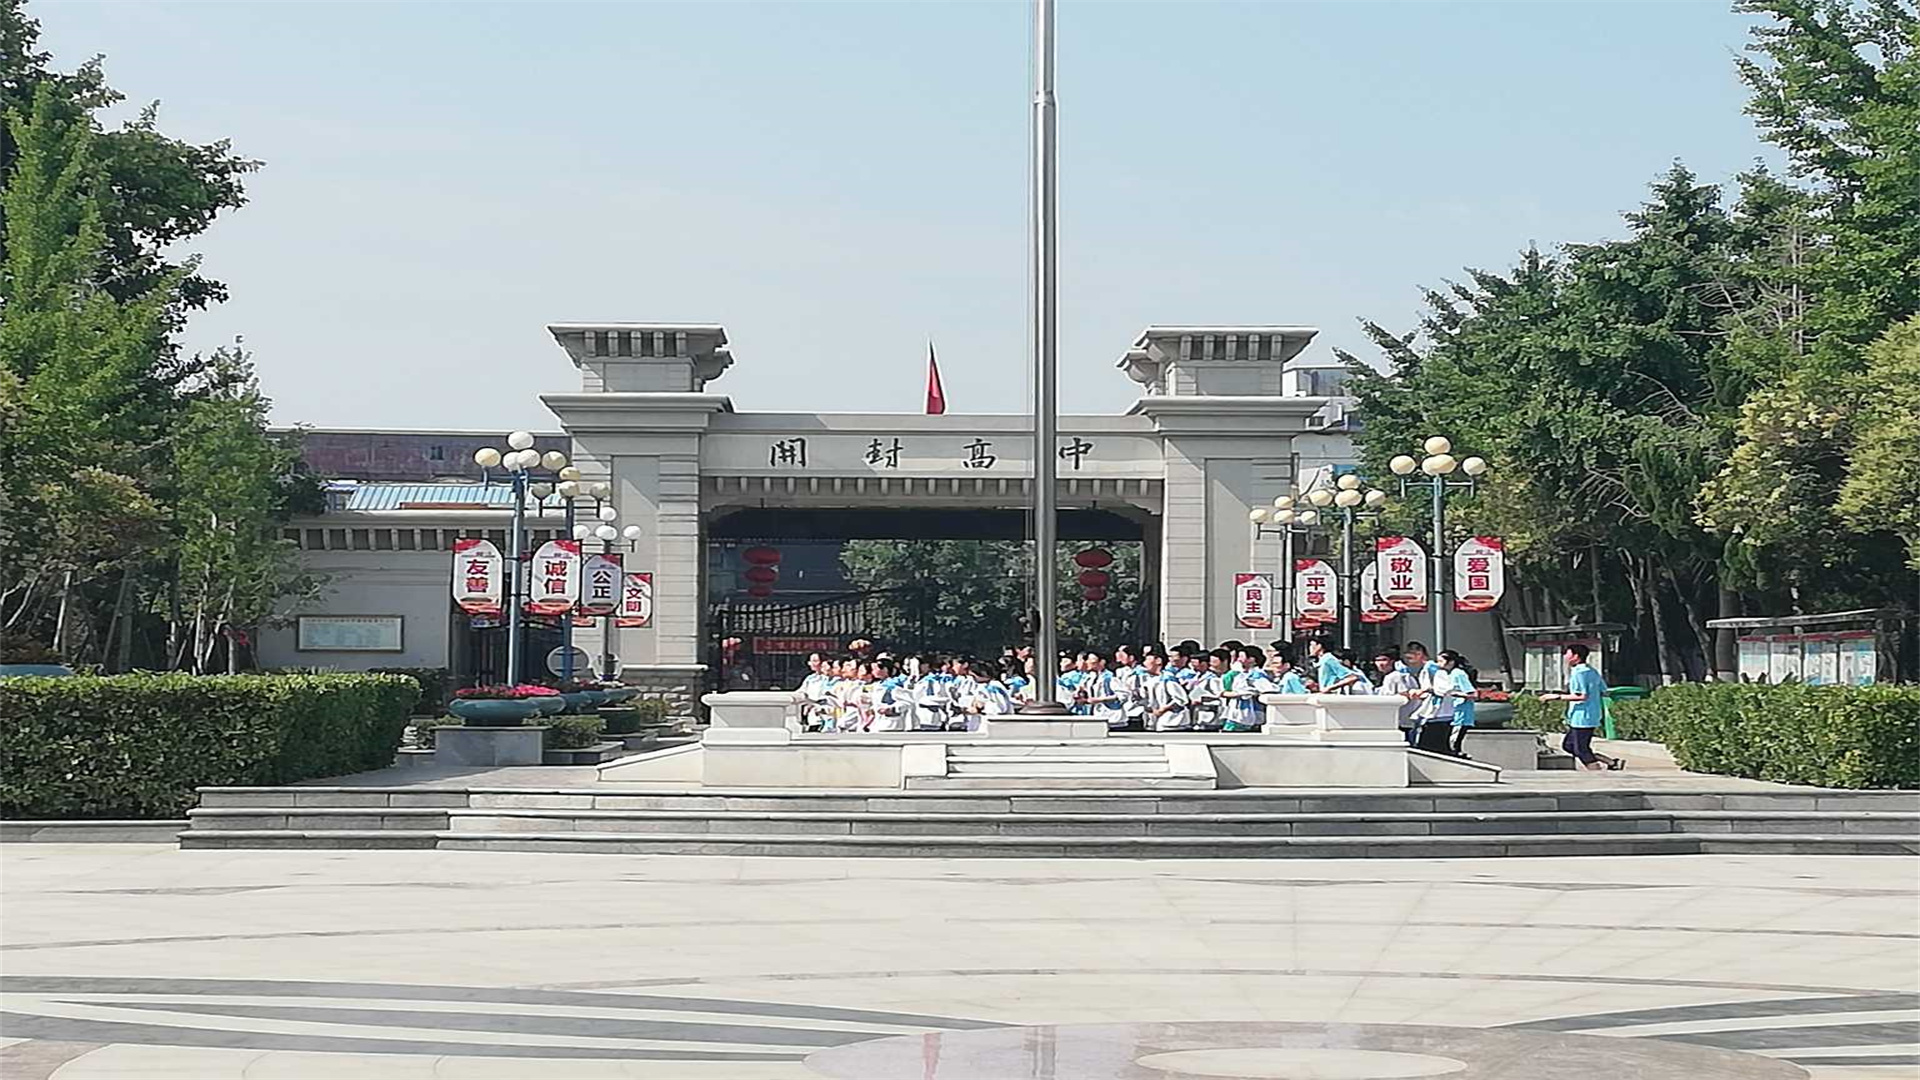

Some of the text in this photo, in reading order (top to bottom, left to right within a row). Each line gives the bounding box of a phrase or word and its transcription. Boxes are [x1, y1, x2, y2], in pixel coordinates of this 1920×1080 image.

[769, 437, 1094, 470] 開封高中
[467, 559, 489, 593] 友善
[545, 560, 568, 594] 诚信
[592, 570, 611, 599] 公正
[1390, 557, 1413, 590] 敬业
[1467, 557, 1490, 590] 爱国
[1246, 589, 1262, 613] 民主
[1306, 577, 1325, 605] 平等
